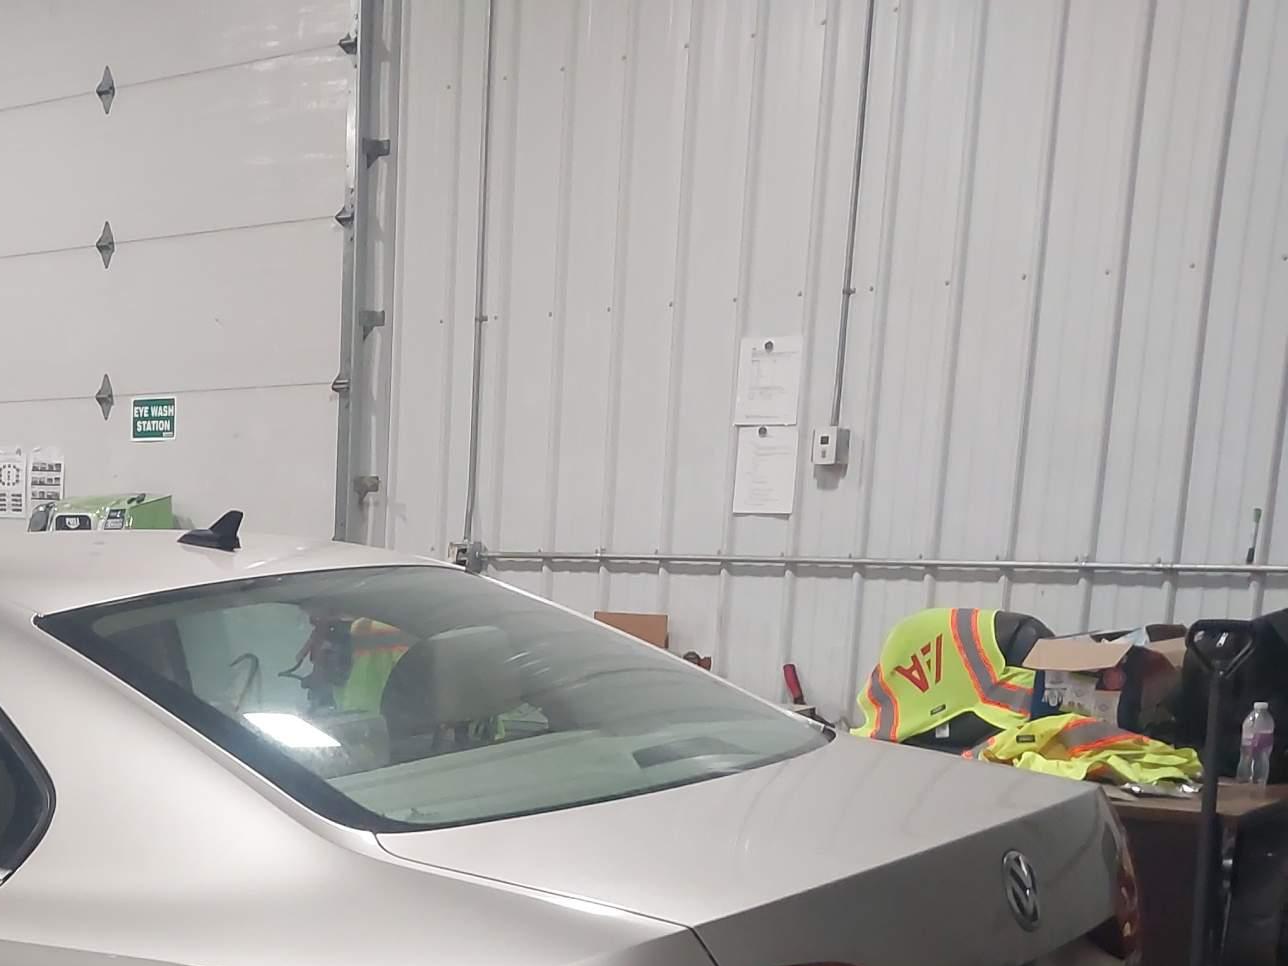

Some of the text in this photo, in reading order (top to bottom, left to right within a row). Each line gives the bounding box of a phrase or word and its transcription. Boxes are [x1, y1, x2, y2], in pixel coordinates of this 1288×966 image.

[134, 405, 174, 417] EYE WASH
[136, 419, 171, 432] STATION
